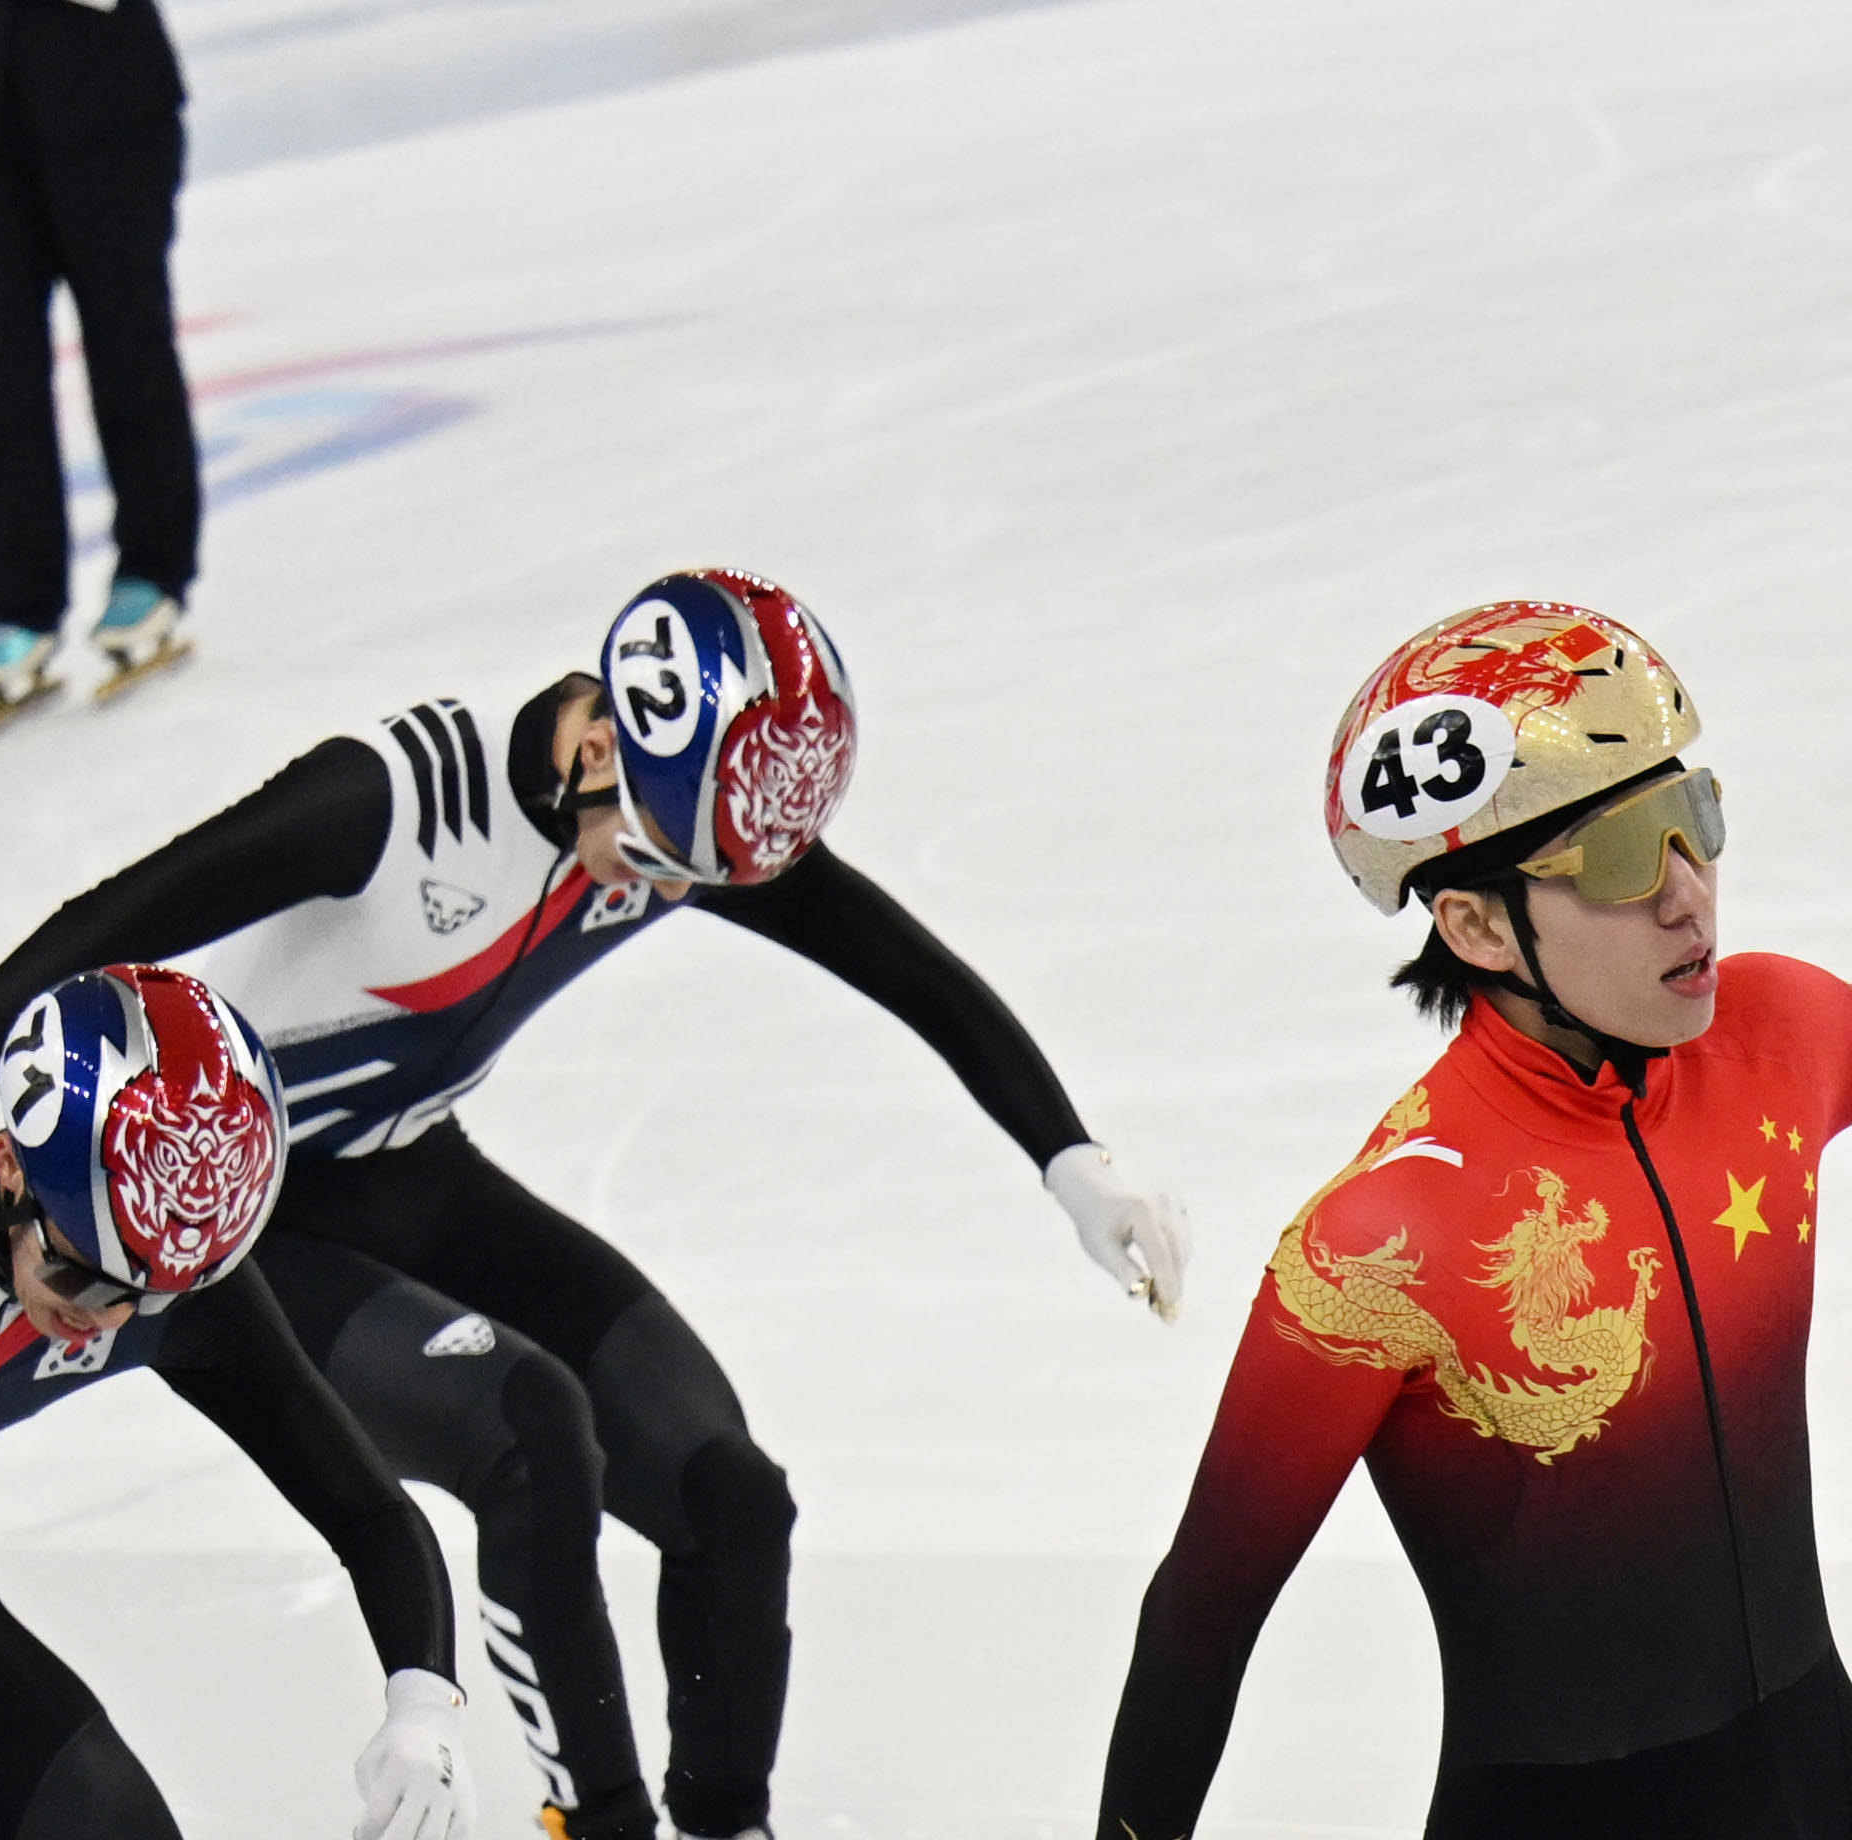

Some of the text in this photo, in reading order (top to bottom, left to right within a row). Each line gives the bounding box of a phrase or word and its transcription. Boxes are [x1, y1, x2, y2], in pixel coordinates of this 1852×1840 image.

[619, 615, 686, 739] 72
[1361, 709, 1486, 819] 43
[3, 1004, 56, 1129] 71
